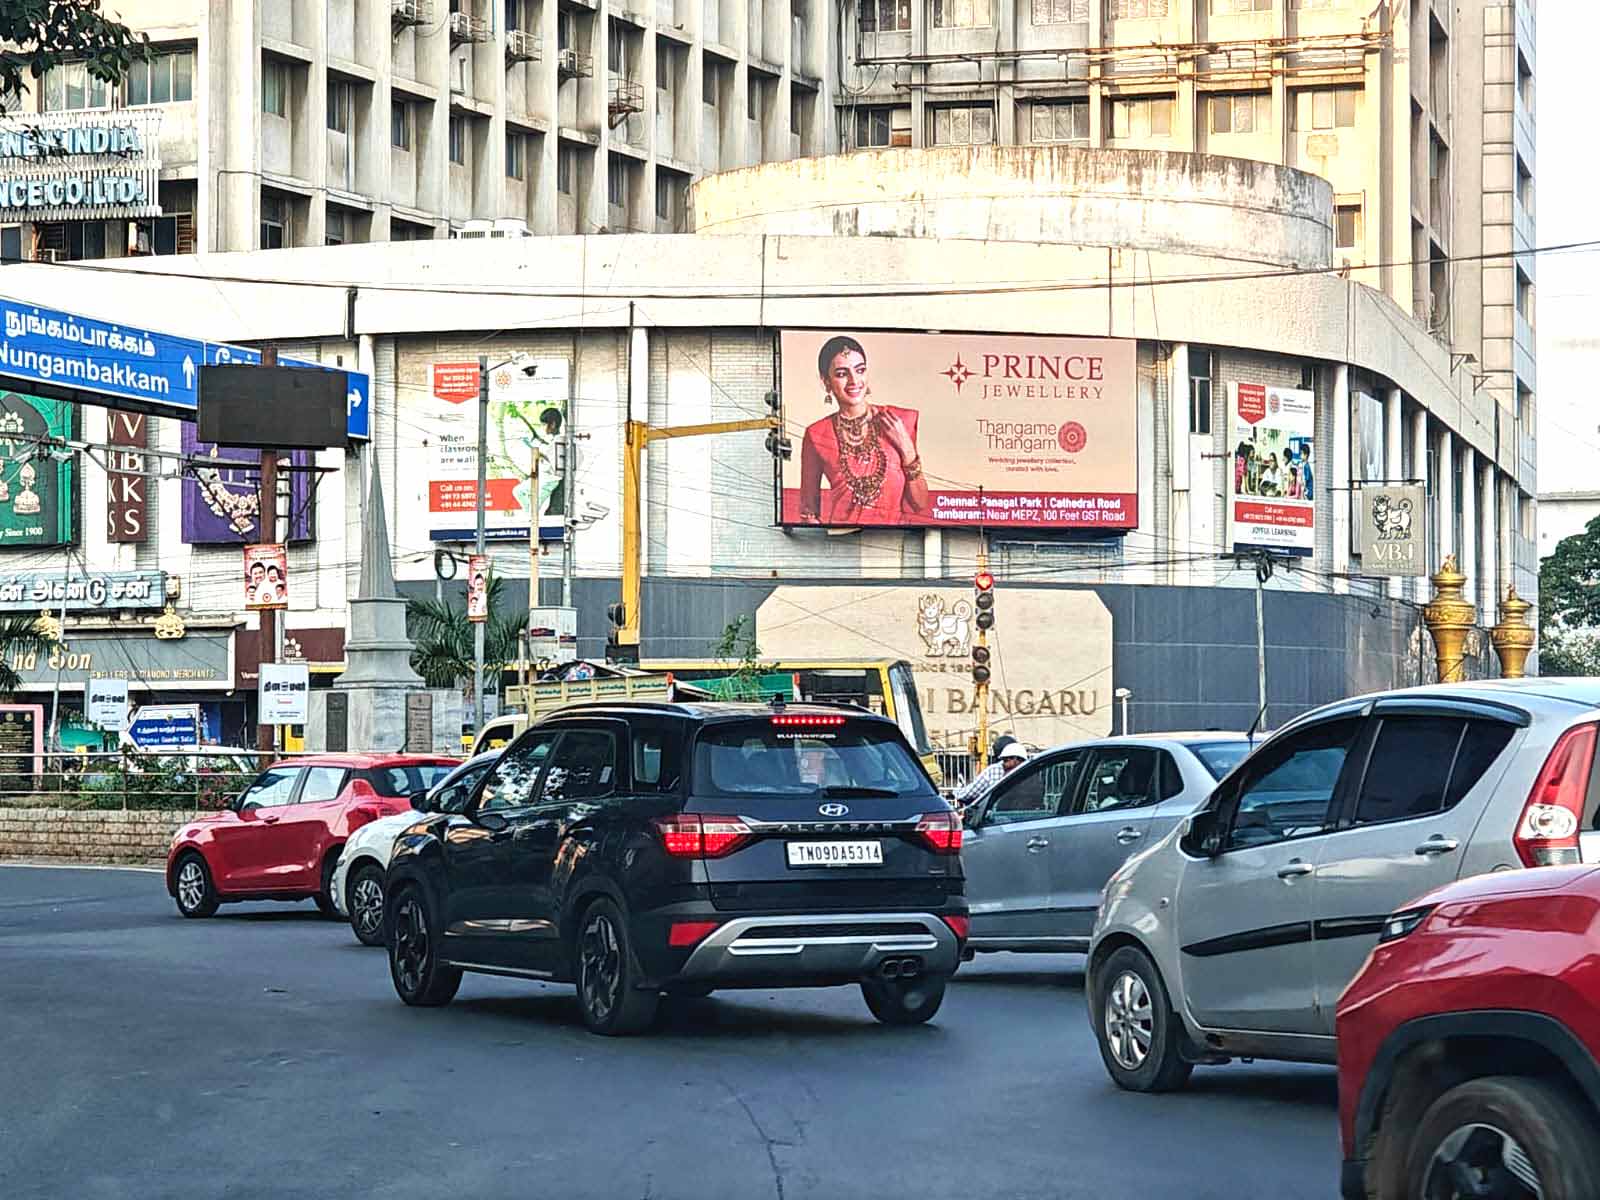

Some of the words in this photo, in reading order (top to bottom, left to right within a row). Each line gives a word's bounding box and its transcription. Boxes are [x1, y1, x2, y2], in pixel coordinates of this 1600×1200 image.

[67, 127, 139, 153] INDIA
[5, 309, 156, 357] நுங்கம்பாக்கம்
[982, 355, 1104, 381] PRINCE
[982, 384, 1104, 400] JEWELLERY
[440, 434, 464, 443] When
[977, 419, 1057, 439] Thangame
[985, 434, 1057, 453] Thangam
[981, 496, 1018, 509] Panagal
[1020, 498, 1042, 508] Park
[1050, 498, 1096, 510] Cathedral
[1097, 499, 1121, 509] Road
[932, 508, 986, 520] Tambaram:
[986, 509, 1010, 520] Near
[1011, 510, 1041, 522] MEPZ,
[1042, 511, 1058, 520] 100
[1060, 511, 1080, 521] Feet
[1082, 512, 1101, 521] GST
[1103, 512, 1126, 521] Road
[111, 575, 150, 599] சன்
[947, 688, 1097, 716] BANGARU
